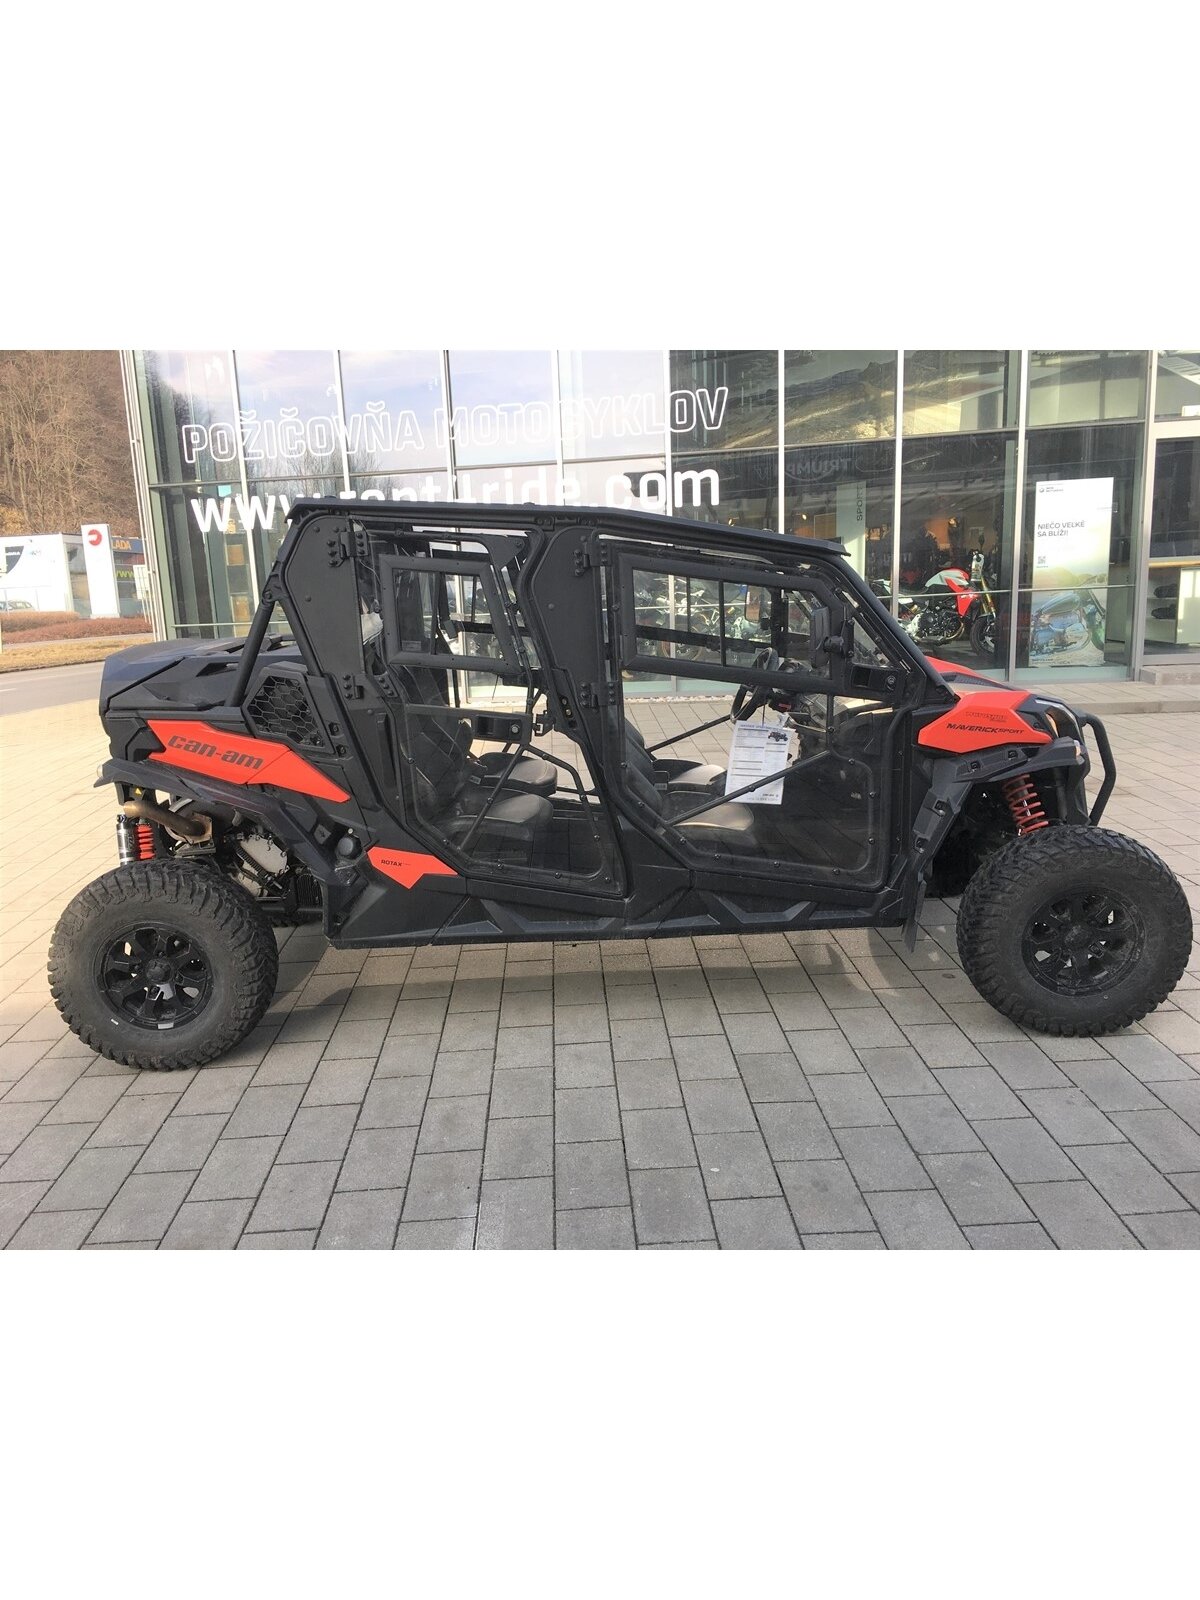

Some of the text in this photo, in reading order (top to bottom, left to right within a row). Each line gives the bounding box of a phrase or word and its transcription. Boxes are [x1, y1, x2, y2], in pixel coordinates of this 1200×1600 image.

[182, 401, 424, 463] POŽIČOVŇA
[1037, 520, 1085, 530] NIEČO VELKÉ
[112, 540, 131, 551] LADA
[381, 859, 403, 867] ROTAX
